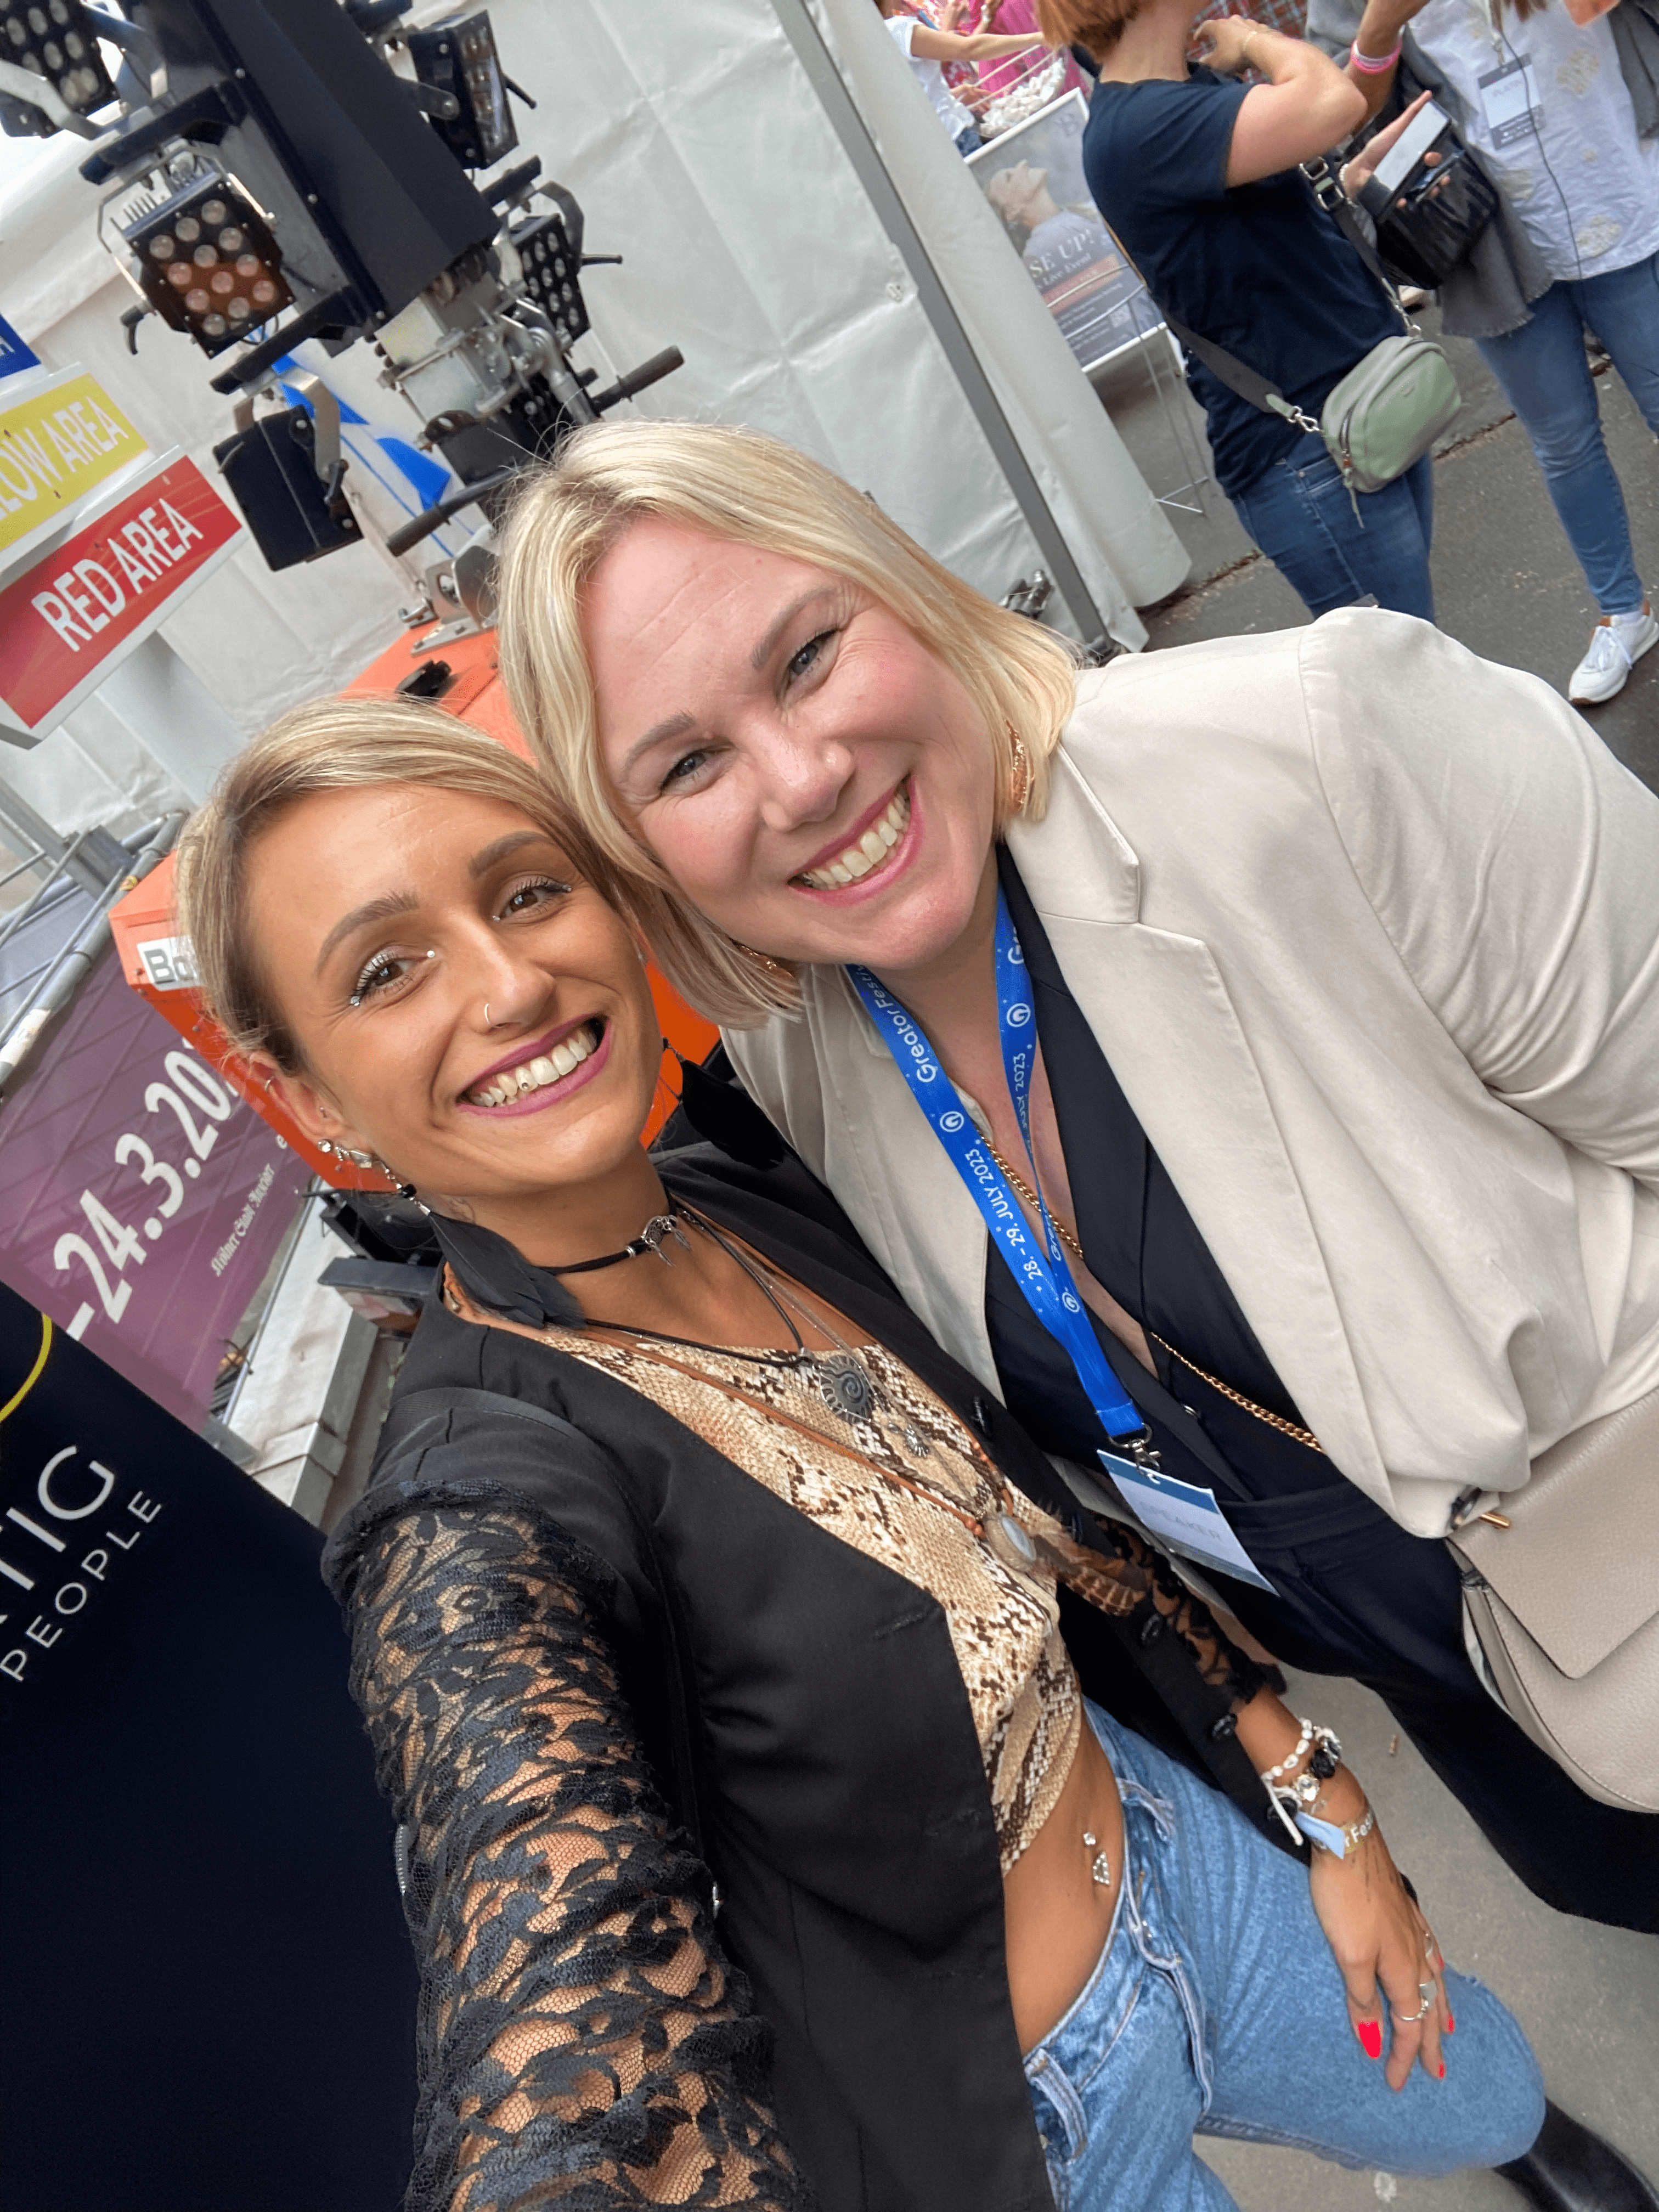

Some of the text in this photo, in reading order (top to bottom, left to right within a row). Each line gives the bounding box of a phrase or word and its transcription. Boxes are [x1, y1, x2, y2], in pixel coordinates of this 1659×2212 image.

[1029, 252, 1056, 278] SE
[41, 396, 129, 473] AREA
[31, 498, 204, 651] RED AREA
[1013, 1053, 1026, 1092] 2023
[965, 1149, 994, 1184] 2023
[984, 1187, 1013, 1219] JULY
[1006, 1222, 1025, 1246] 29.
[1023, 1256, 1043, 1280] 28.
[0, 1491, 161, 1682] PEOPLE
